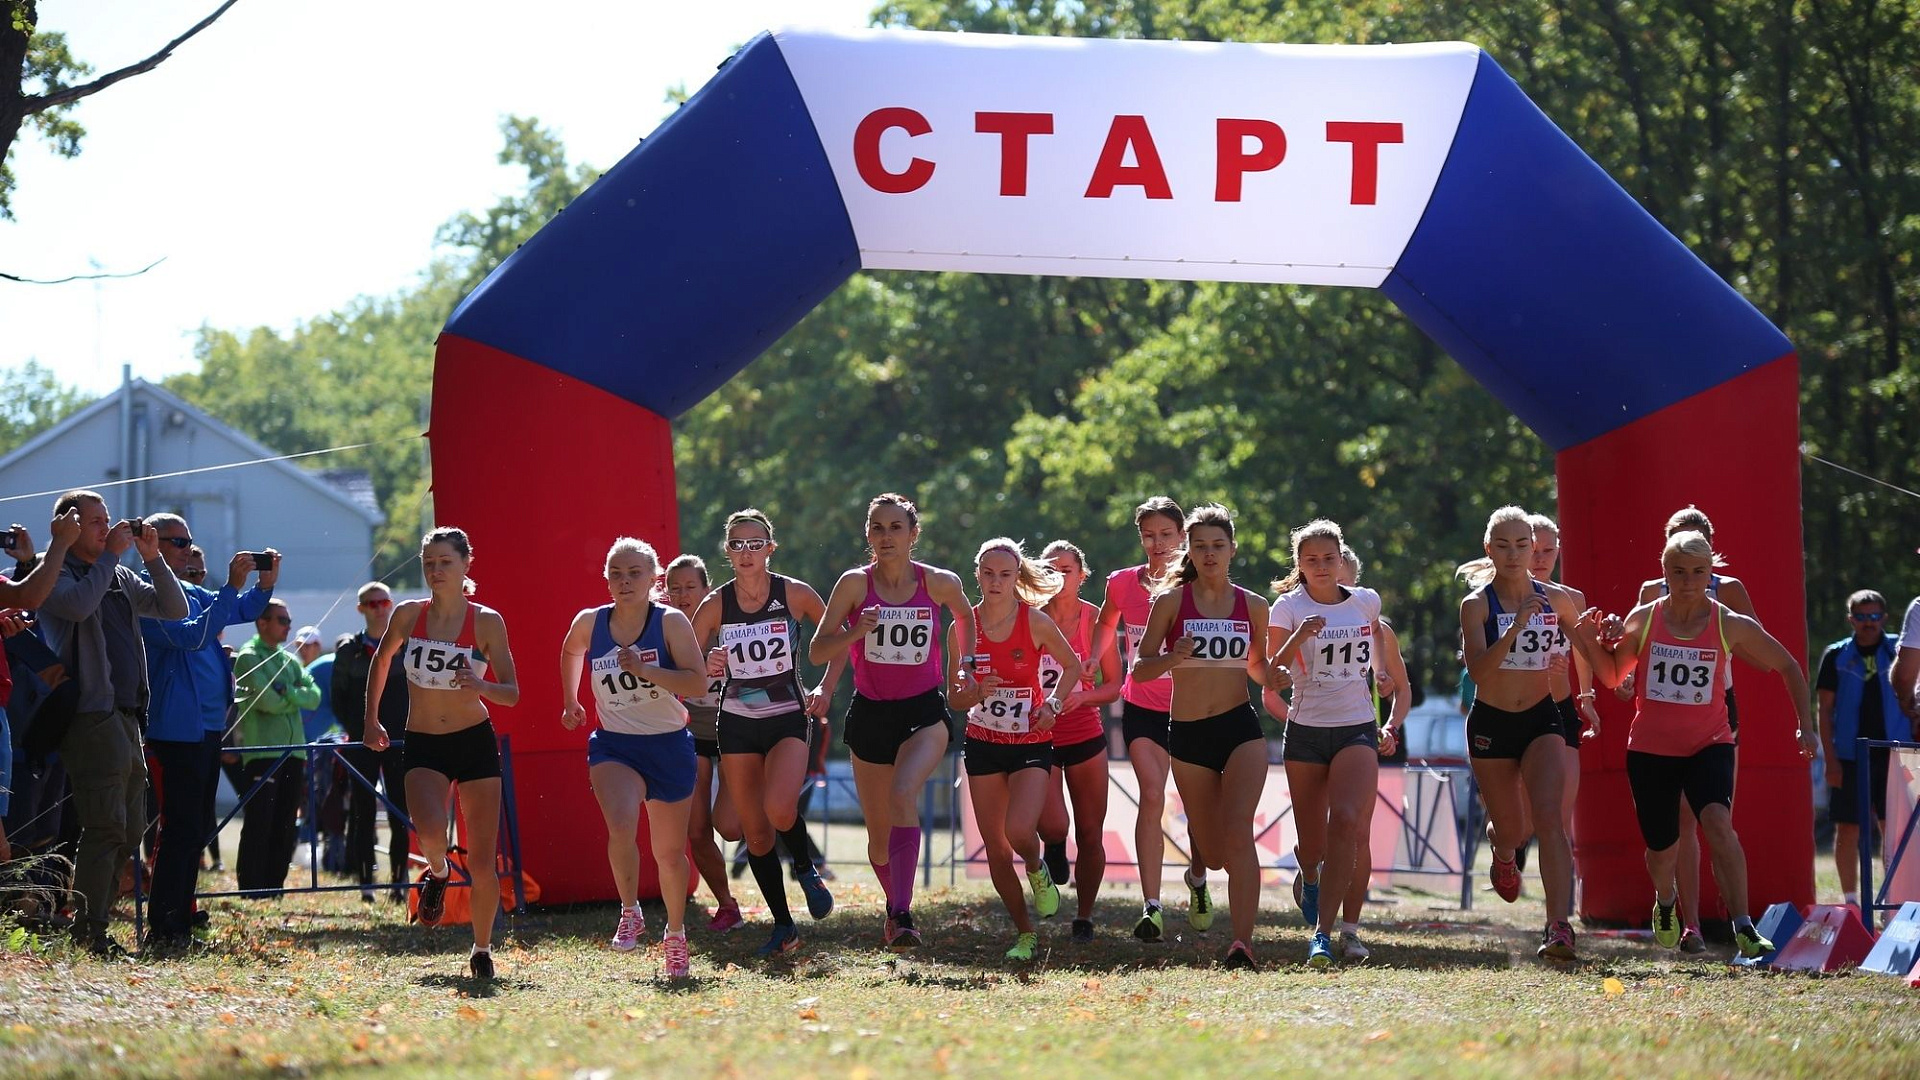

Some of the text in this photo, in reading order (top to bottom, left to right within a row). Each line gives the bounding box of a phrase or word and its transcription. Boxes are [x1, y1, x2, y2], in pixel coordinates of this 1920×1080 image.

[853, 106, 1404, 206] СТАРТ
[878, 609, 902, 620] МАРА
[724, 628, 757, 641] САМАРА
[871, 623, 928, 648] 106
[1184, 622, 1219, 632] САМАРА
[410, 645, 465, 673] 154
[730, 637, 787, 664] 102
[1189, 636, 1246, 659] 200
[1320, 640, 1370, 666] 113
[1651, 645, 1684, 660] САМАРА
[593, 659, 619, 671] САМА
[1652, 660, 1710, 688] 103
